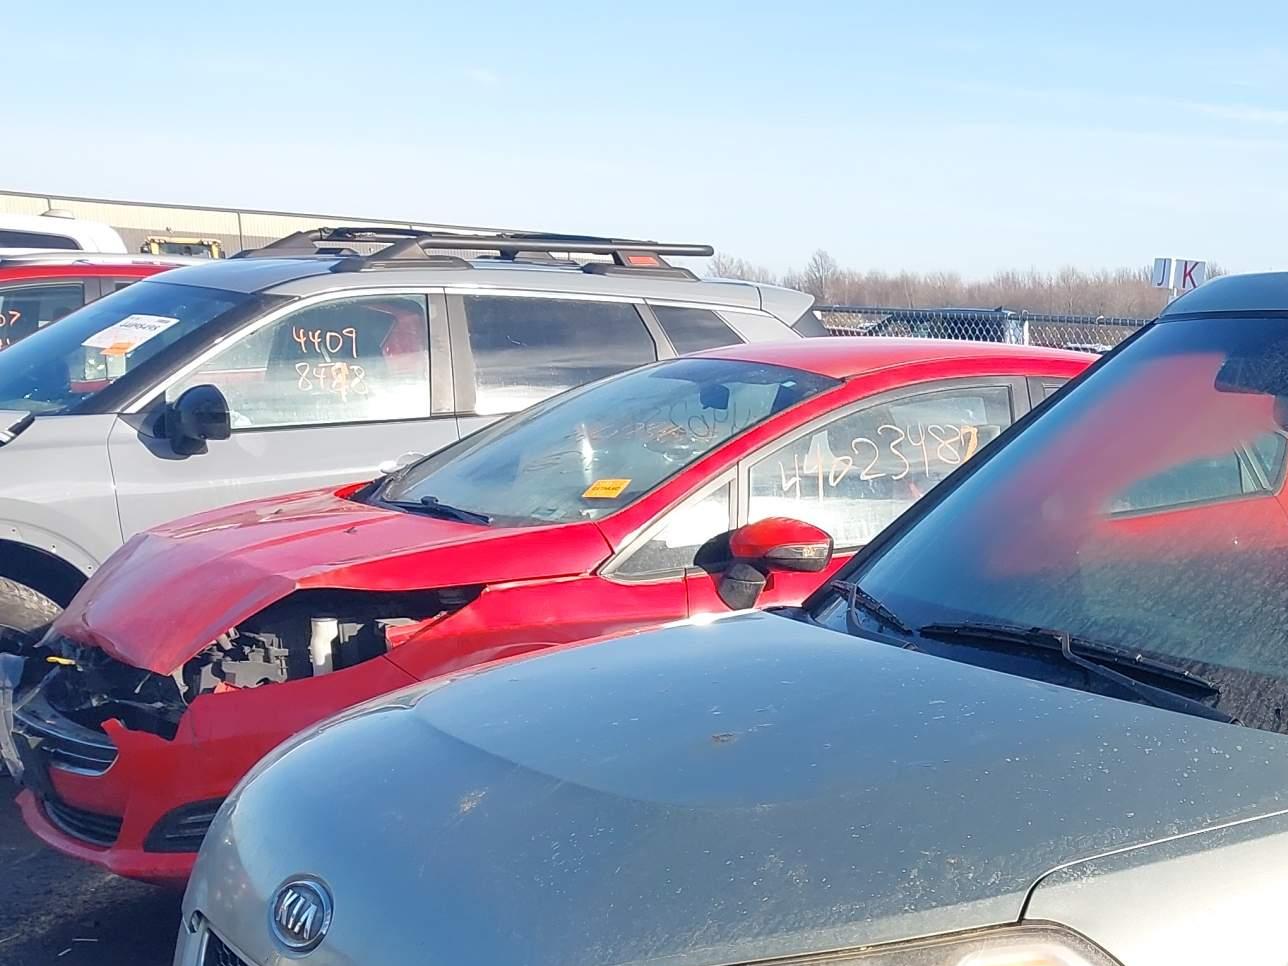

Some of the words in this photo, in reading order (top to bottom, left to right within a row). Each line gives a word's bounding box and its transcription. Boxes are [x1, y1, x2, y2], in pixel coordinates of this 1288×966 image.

[1156, 258, 1167, 287] J
[1181, 260, 1200, 289] K
[292, 325, 358, 359] 4409
[778, 423, 980, 502] 44023487
[275, 888, 318, 940] KIA
